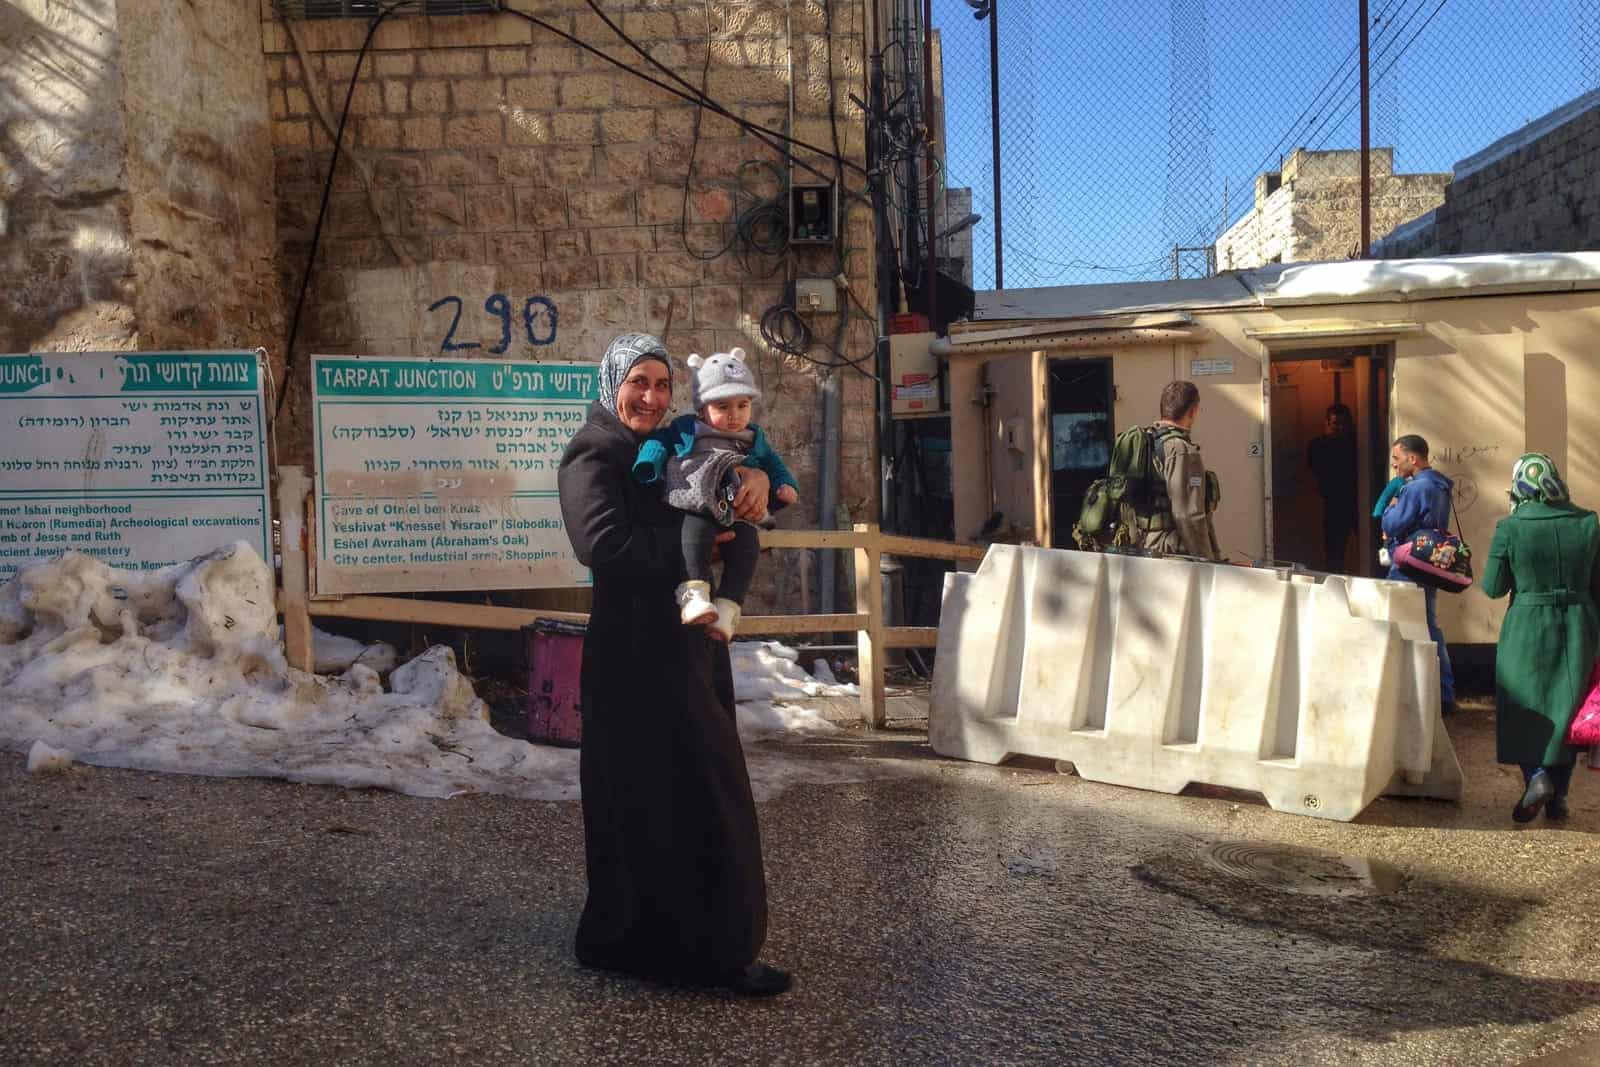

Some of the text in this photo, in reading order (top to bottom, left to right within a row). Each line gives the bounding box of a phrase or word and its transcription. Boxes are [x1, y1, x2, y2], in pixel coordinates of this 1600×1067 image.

[426, 293, 559, 354] 290
[156, 362, 202, 389] קדושי
[207, 362, 249, 382] צומת
[321, 367, 476, 389] TARPAT JUNCTION
[492, 364, 544, 391] תרפ"ט
[549, 373, 592, 398] קדושי
[153, 401, 202, 411] אדמות
[221, 416, 252, 425] אתר
[467, 409, 482, 423] בן
[486, 408, 539, 421] עתניאל
[543, 409, 583, 421] מערת
[89, 416, 130, 427] חברון
[160, 416, 217, 427] עתיקות
[194, 431, 219, 440] ישי
[224, 430, 253, 440] קבר
[226, 445, 254, 453] בית
[495, 442, 546, 453] אברהם
[1251, 445, 1260, 455] 2
[364, 460, 401, 472] קניון
[467, 459, 499, 470] אזור
[24, 505, 51, 515] Ishai
[55, 504, 132, 517] neighborhood
[366, 504, 378, 515] of
[49, 518, 106, 530] (Rumedia)
[110, 516, 188, 529] Archeological
[192, 517, 260, 527] excavations
[332, 521, 386, 533] Yeshivat
[501, 518, 563, 531] (Slobodka)
[20, 532, 31, 542] of
[35, 532, 68, 542] Jesse
[71, 532, 91, 542] and
[95, 531, 121, 541] Ruth
[333, 534, 529, 549] Eshel Avraham (Abraham's Oak)
[333, 553, 359, 566] City
[410, 551, 468, 563] Industrial
